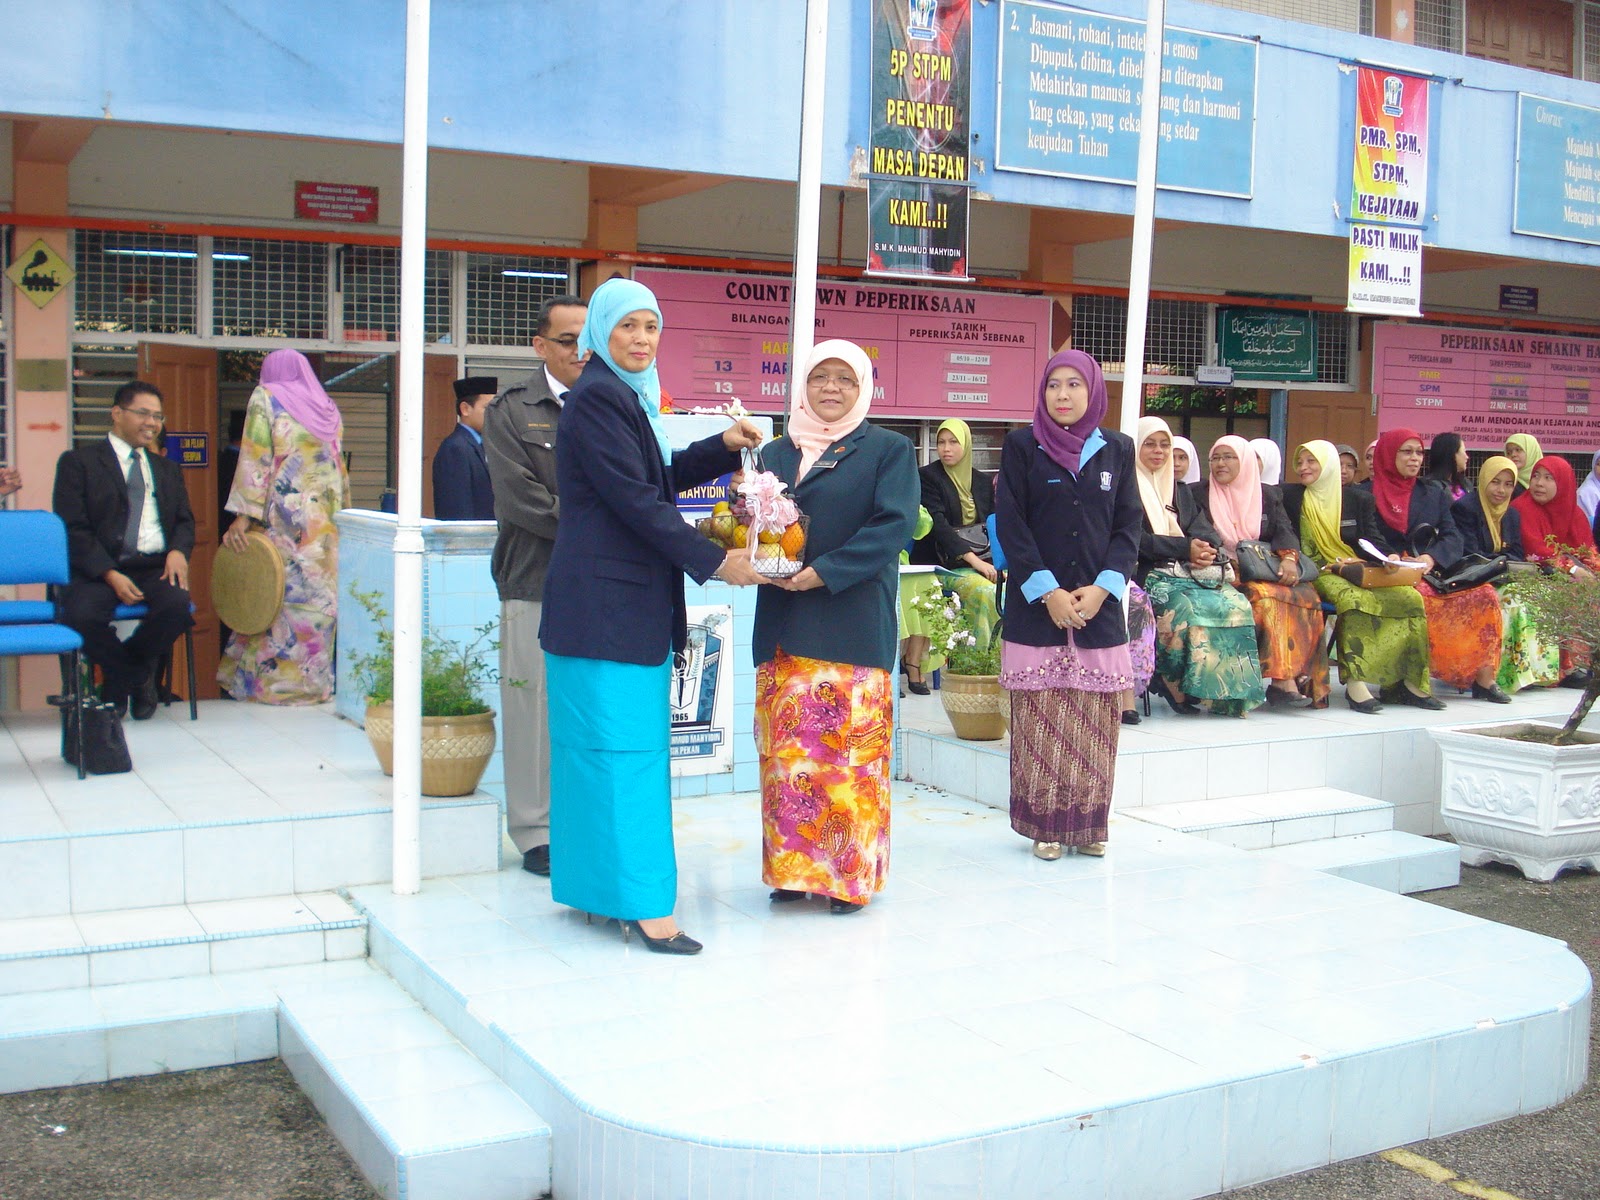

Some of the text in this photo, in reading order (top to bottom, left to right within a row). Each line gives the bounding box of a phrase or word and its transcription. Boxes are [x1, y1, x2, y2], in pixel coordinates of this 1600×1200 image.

[1010, 9, 1020, 31] 2.
[1030, 14, 1075, 44] Jasmani,
[1078, 23, 1114, 50] rohani,
[913, 52, 951, 81] STPM
[1031, 42, 1077, 71] Dipupuk,
[1081, 50, 1115, 77] dibina,
[1174, 65, 1223, 93] diterapkan
[1030, 71, 1088, 98] Melahirkan
[1091, 84, 1131, 104] manusia
[1183, 94, 1200, 115] dan
[1203, 97, 1240, 120] harmoni
[887, 98, 954, 131] PENENTU
[1029, 99, 1053, 127] Yang
[1056, 104, 1088, 130] cekap,
[1091, 112, 1114, 133] yang
[1174, 120, 1199, 141] sedar
[1028, 128, 1108, 157] keujudan Tuhan
[1360, 127, 1421, 154] PMR, SPM,
[1565, 137, 1594, 160] Majulah
[874, 147, 964, 181] MASA DEPAN
[1373, 162, 1408, 185] STPM,
[1564, 160, 1592, 182] Majulah
[1359, 194, 1419, 218] KEJAYAAN
[874, 243, 961, 257] S.M.K. MAHMUD MAHYIDIN
[1353, 227, 1419, 251] PASTI MILIK
[726, 281, 976, 315] COUNTWN PEPERIKSAAN
[910, 329, 1025, 344] PEPERIKSAAN SEBENAR
[951, 322, 987, 332] TARIKH
[762, 341, 789, 355] HAR
[1440, 333, 1524, 354] PEPERIKSAAN
[1530, 340, 1581, 358] SEMAKIN
[714, 360, 788, 375] 13 HAR
[1419, 370, 1440, 379] PMR
[714, 381, 787, 396] 13 HAR
[1419, 384, 1441, 392] SPM
[1415, 397, 1443, 407] STPM
[1461, 415, 1485, 424] KAMI
[1488, 416, 1542, 426] MENDOAKAN
[1543, 419, 1584, 428] KEJAYAAN
[679, 486, 725, 499] MAHYIDIN
[672, 713, 689, 721] 1965
[671, 732, 721, 745] HMUD MAHYIDIN
[680, 745, 700, 755] PEKAN
